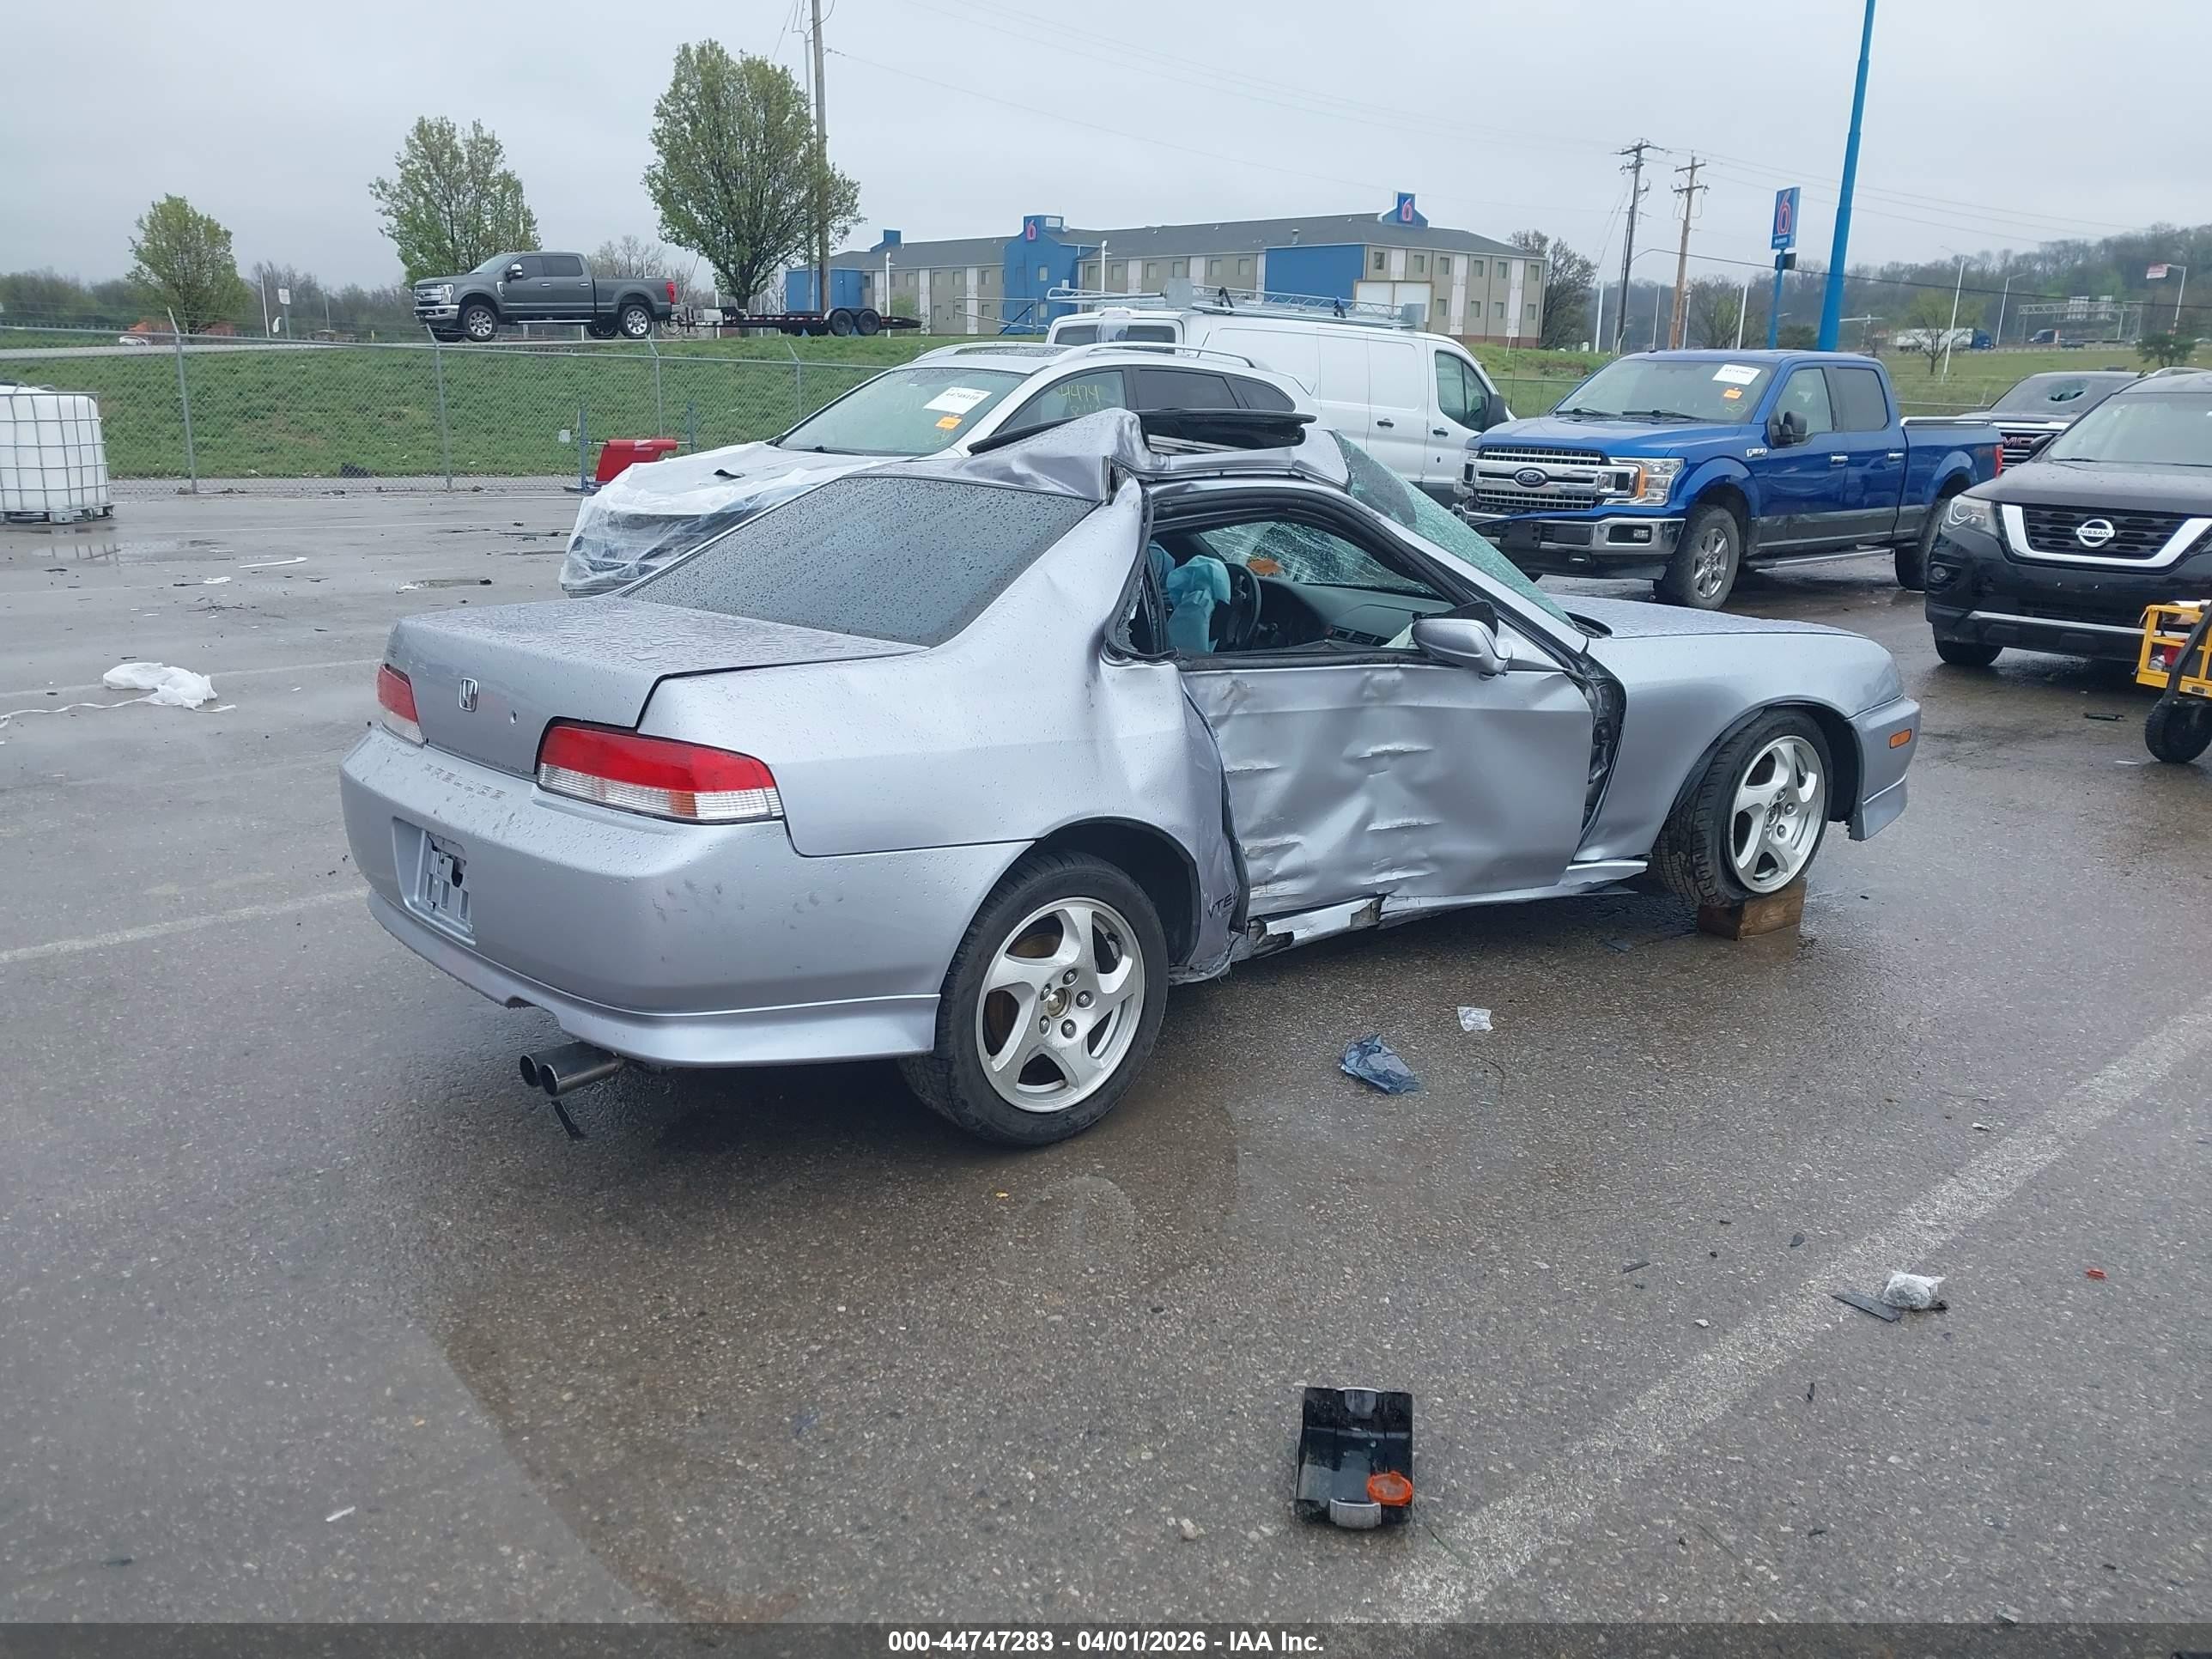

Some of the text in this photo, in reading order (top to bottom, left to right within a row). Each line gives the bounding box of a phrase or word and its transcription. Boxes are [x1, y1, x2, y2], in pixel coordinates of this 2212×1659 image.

[1402, 198, 1413, 222] 6
[1777, 189, 1791, 234] 6
[1026, 219, 1036, 240] 6
[2002, 436, 2034, 447] MC
[1521, 472, 1538, 482] Ford
